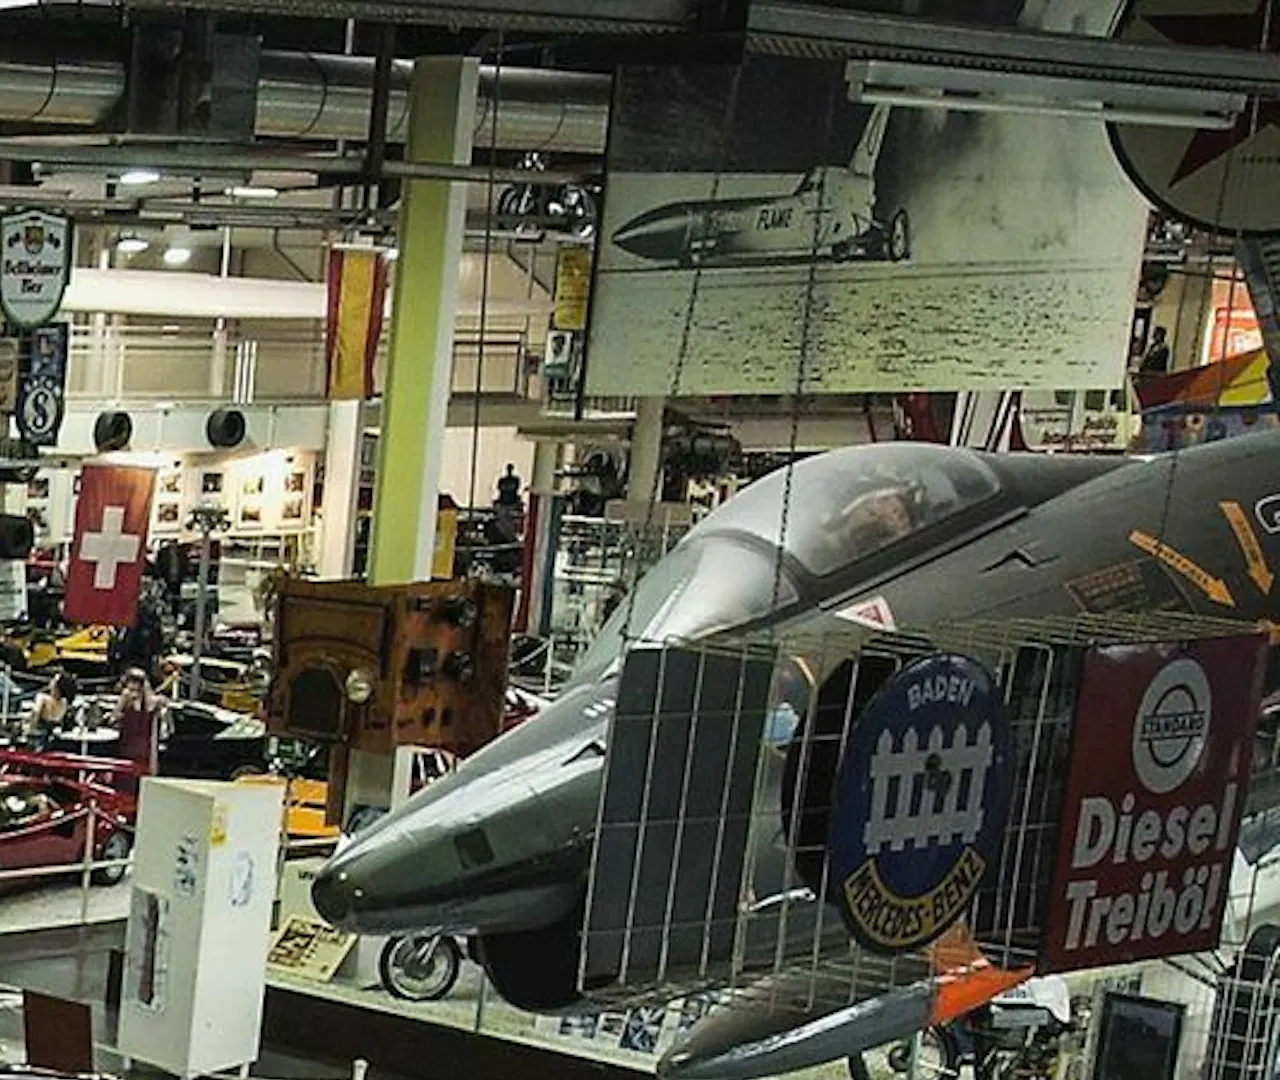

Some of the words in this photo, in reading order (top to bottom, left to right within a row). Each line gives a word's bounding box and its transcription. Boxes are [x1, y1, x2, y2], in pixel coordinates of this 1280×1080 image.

[907, 671, 975, 711] BADEN
[1141, 711, 1205, 736] STANDARD
[1071, 783, 1239, 869] Diesel
[845, 850, 982, 940] MERCEDES-BENZ
[1063, 862, 1223, 951] Treiböl
